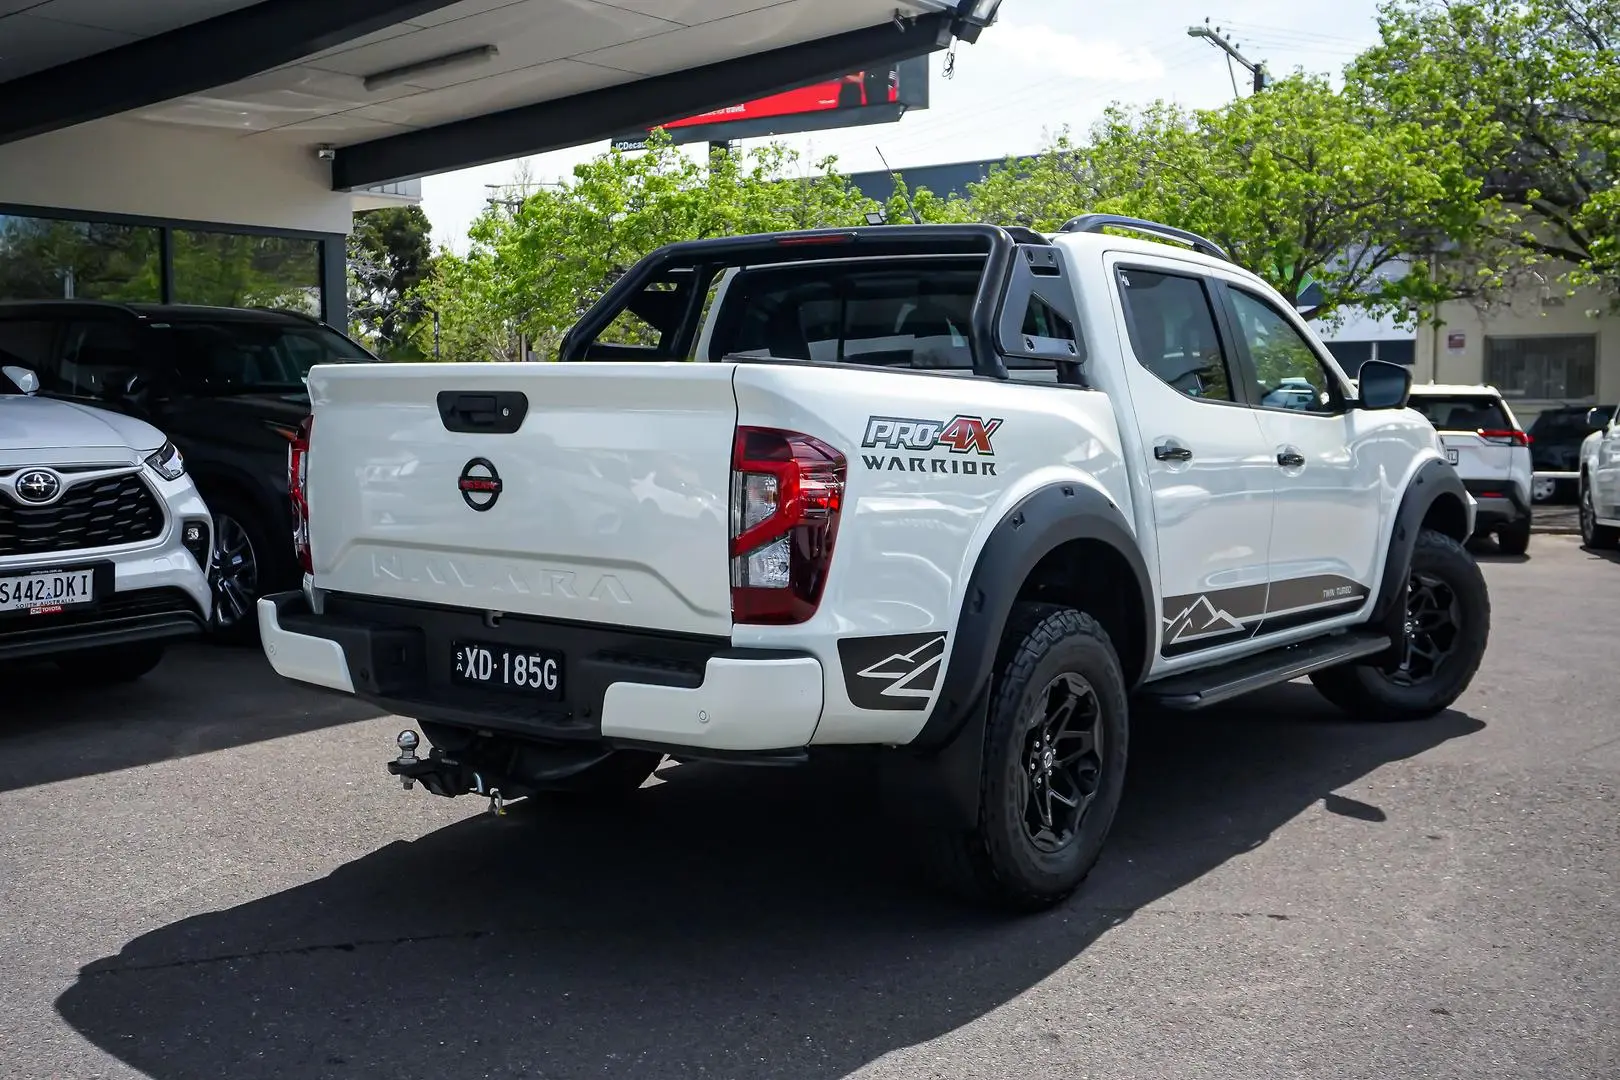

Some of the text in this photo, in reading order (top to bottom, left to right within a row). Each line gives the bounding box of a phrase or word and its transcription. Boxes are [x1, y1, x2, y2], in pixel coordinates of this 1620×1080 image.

[616, 141, 646, 149] JCDecau
[861, 455, 997, 476] WARRIOR
[371, 551, 633, 605] NAVARA
[40, 598, 75, 606] AUSTRALIA
